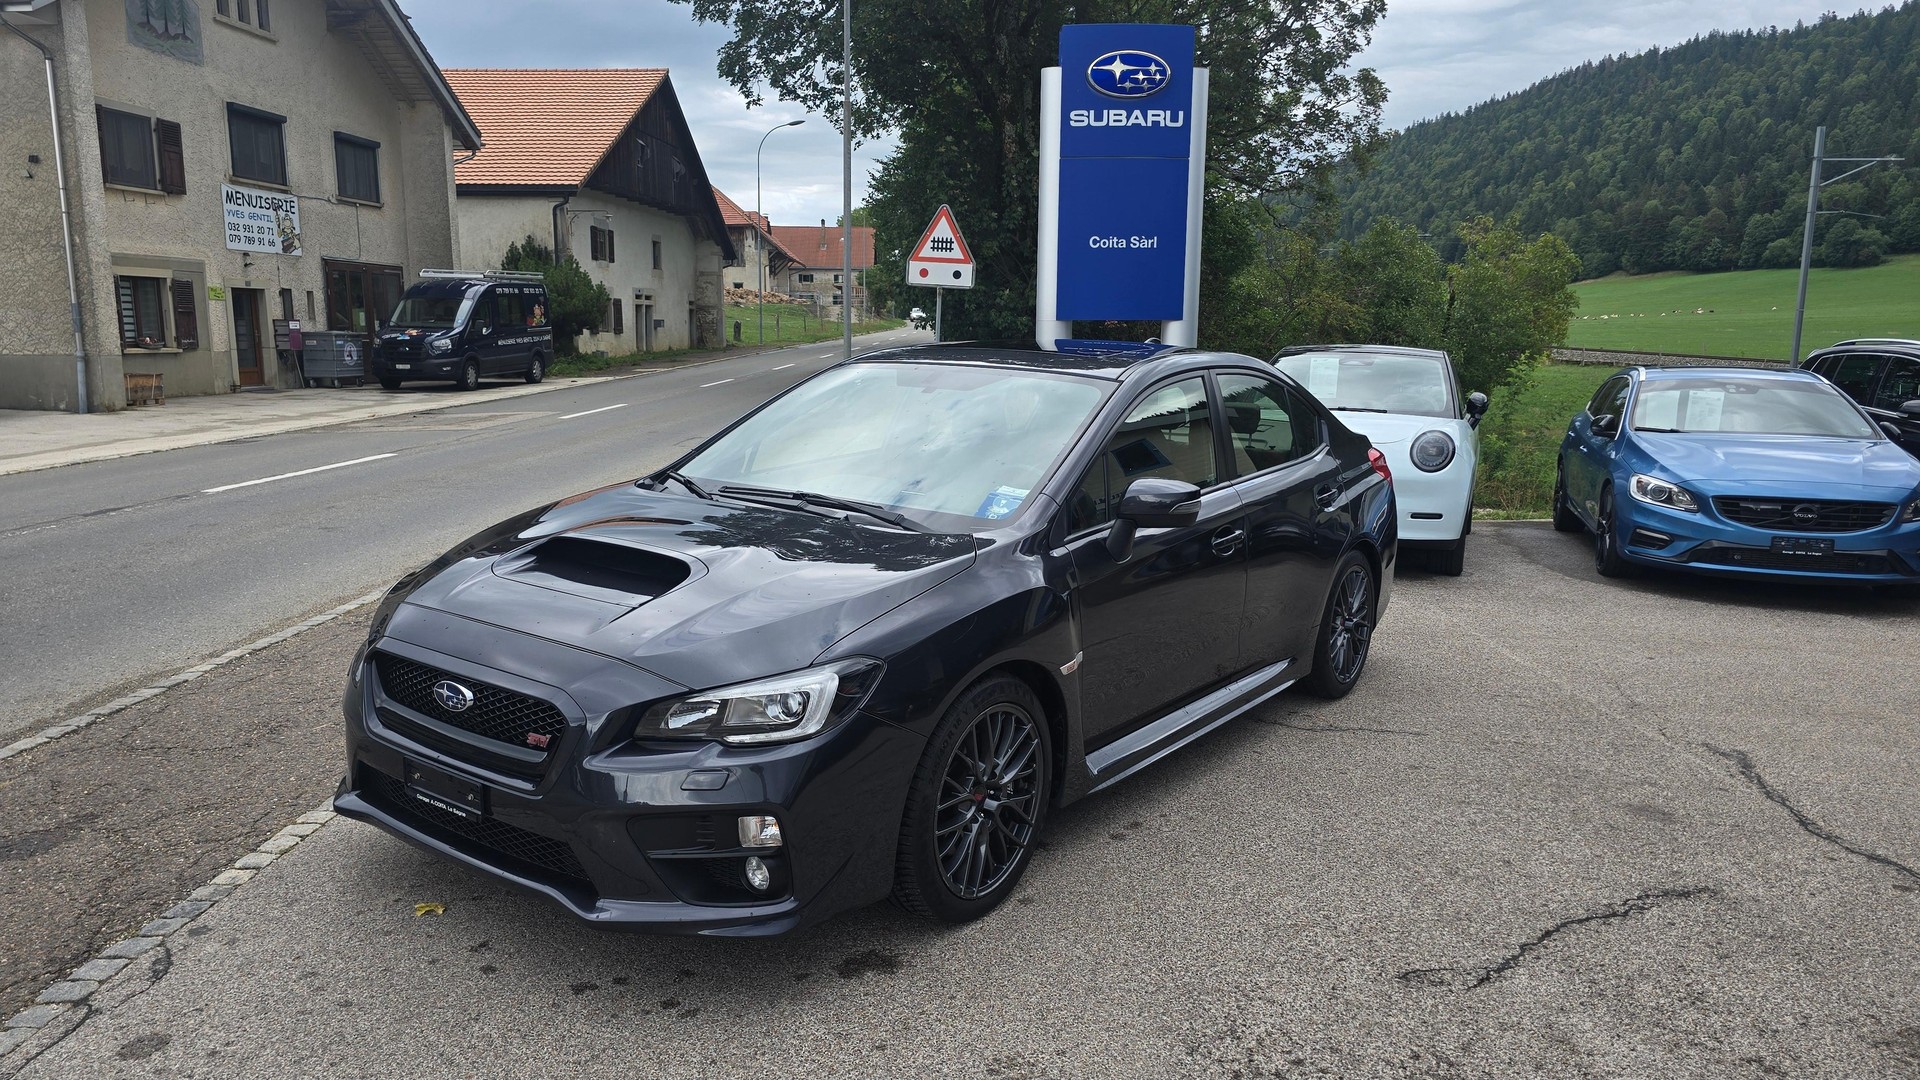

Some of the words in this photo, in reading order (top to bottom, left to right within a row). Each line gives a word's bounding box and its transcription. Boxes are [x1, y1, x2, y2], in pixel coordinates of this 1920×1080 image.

[1070, 110, 1184, 127] SUBARU
[226, 190, 296, 214] MENUISERIE
[226, 209, 244, 218] YVES
[248, 212, 274, 222] GENTIL
[228, 222, 240, 232] 032
[242, 224, 254, 234] 931
[256, 226, 265, 234] 20
[266, 227, 274, 236] 71
[228, 234, 241, 243] 079
[243, 236, 256, 245] 789
[257, 237, 266, 246] 91
[268, 238, 276, 247] 66
[1089, 236, 1126, 248] Coita
[1130, 235, 1157, 248] Sàrl
